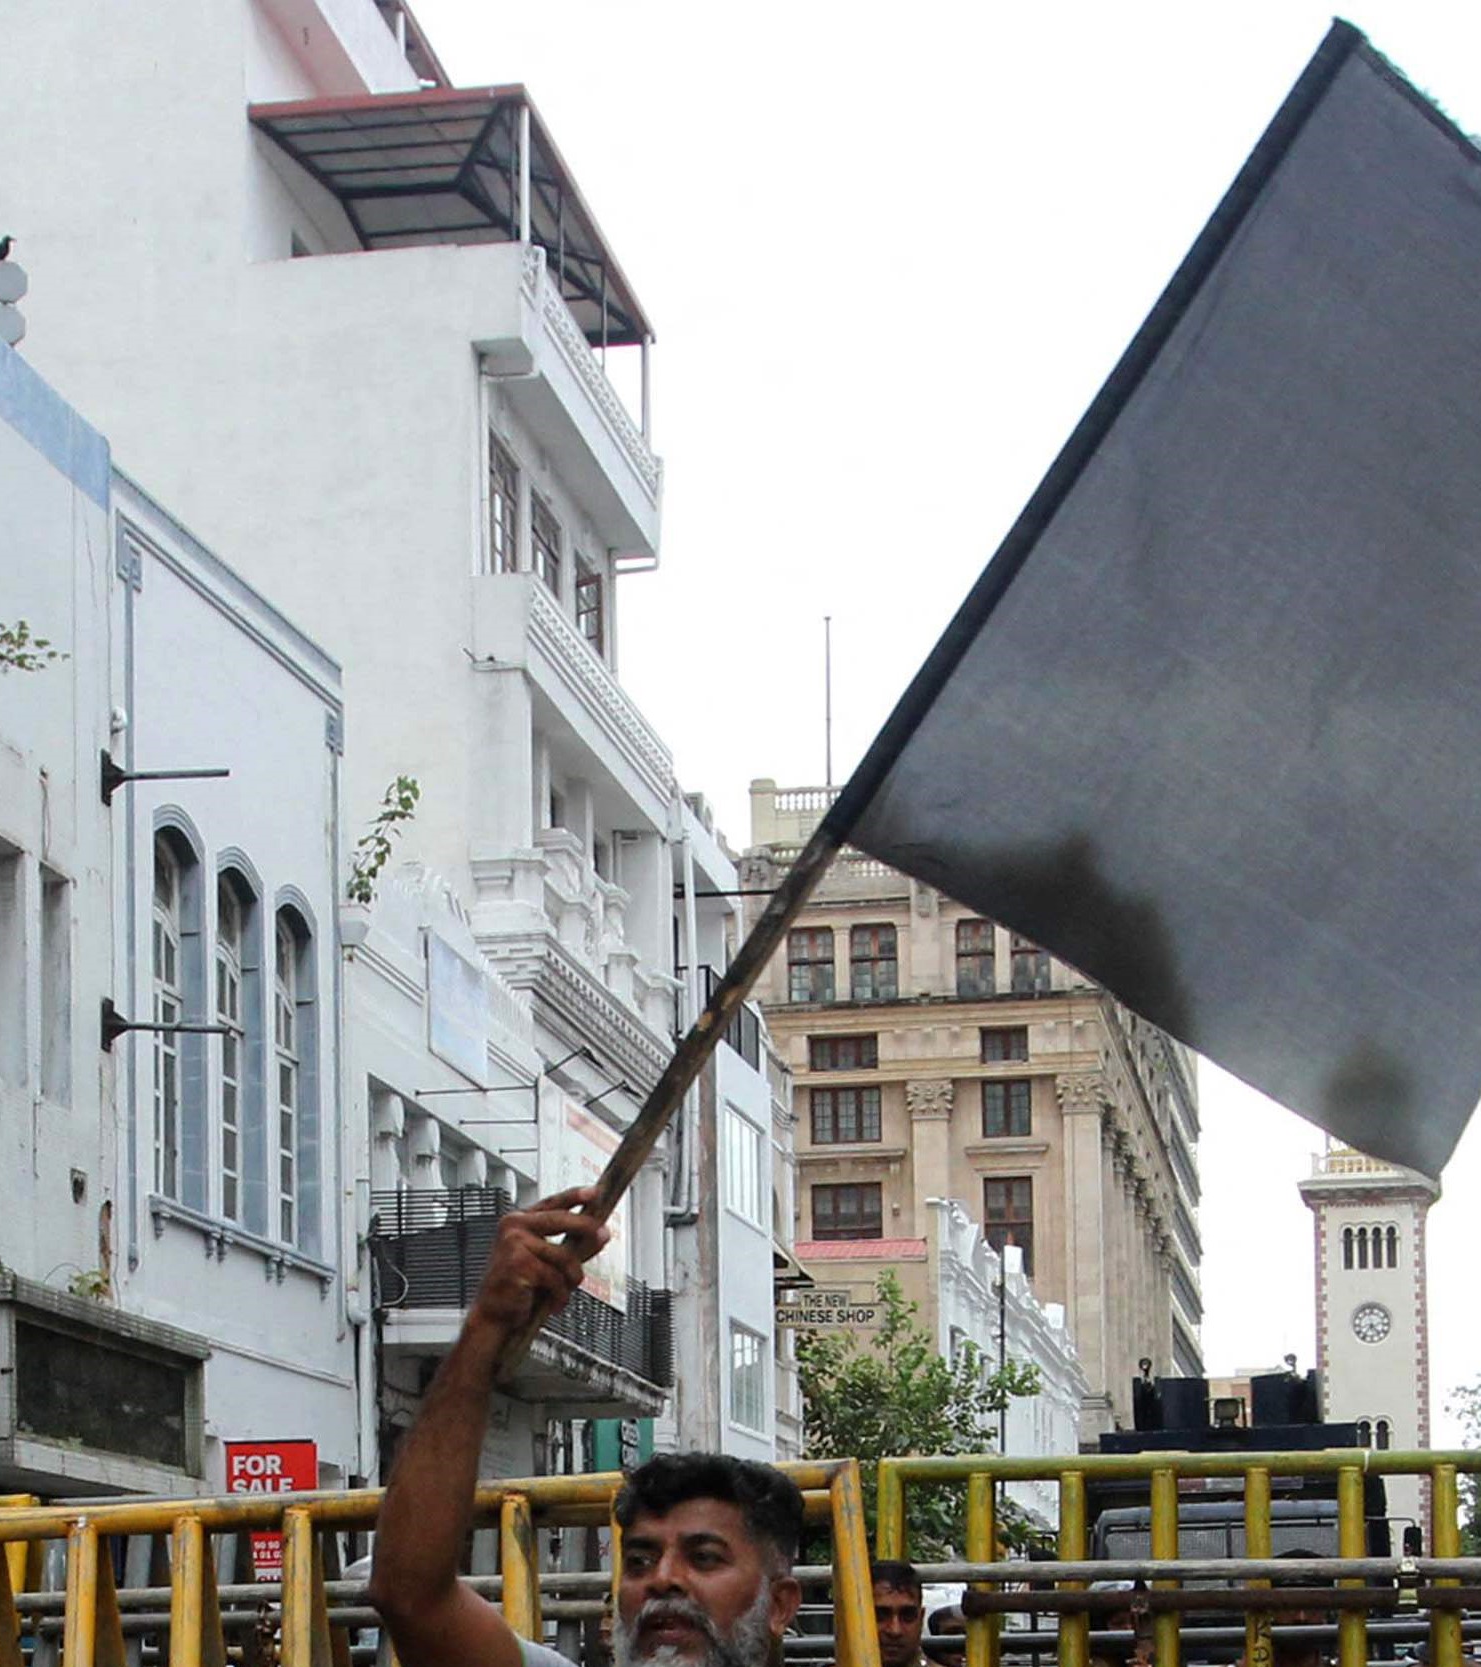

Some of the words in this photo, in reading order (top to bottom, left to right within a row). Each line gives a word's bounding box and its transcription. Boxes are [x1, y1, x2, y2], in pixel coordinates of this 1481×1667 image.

[804, 1294, 824, 1307] THE
[827, 1292, 848, 1307] NEW
[776, 1310, 834, 1323] CHINESE
[837, 1310, 875, 1323] SHOP
[232, 1455, 282, 1476] FOR
[232, 1478, 293, 1494] SALE
